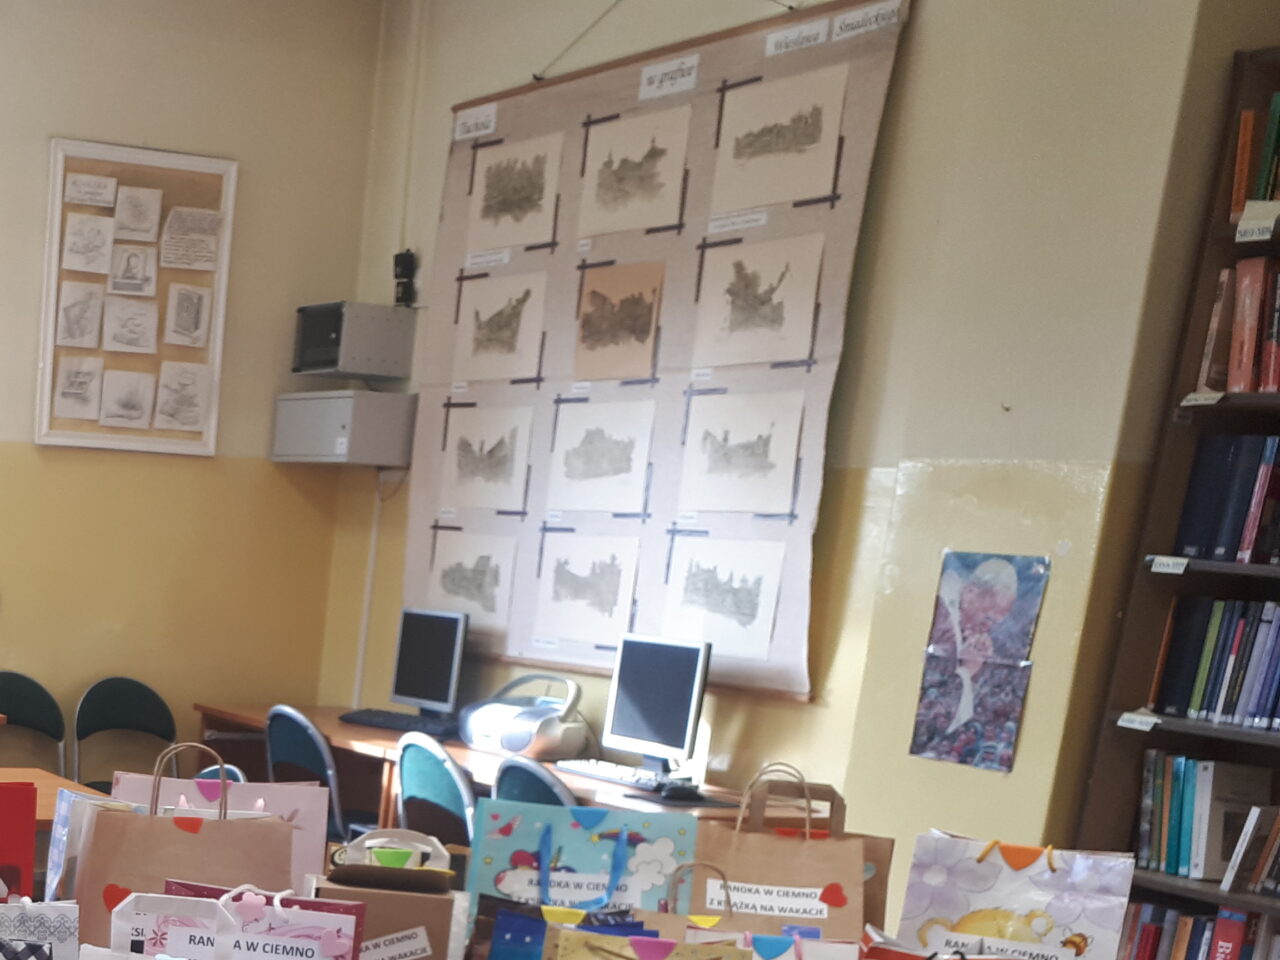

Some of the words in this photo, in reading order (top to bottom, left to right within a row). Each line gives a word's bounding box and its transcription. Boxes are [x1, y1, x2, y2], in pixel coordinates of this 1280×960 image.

[572, 881, 584, 890] W
[763, 889, 774, 897] W
[776, 889, 818, 900] CIEMNO
[760, 904, 775, 913] NA
[778, 906, 825, 916] WAKACJE
[188, 934, 242, 950] RANA
[246, 941, 259, 952] W
[262, 943, 315, 959] CIEMNO
[372, 942, 381, 950] W
[383, 932, 418, 947] CIEMNO
